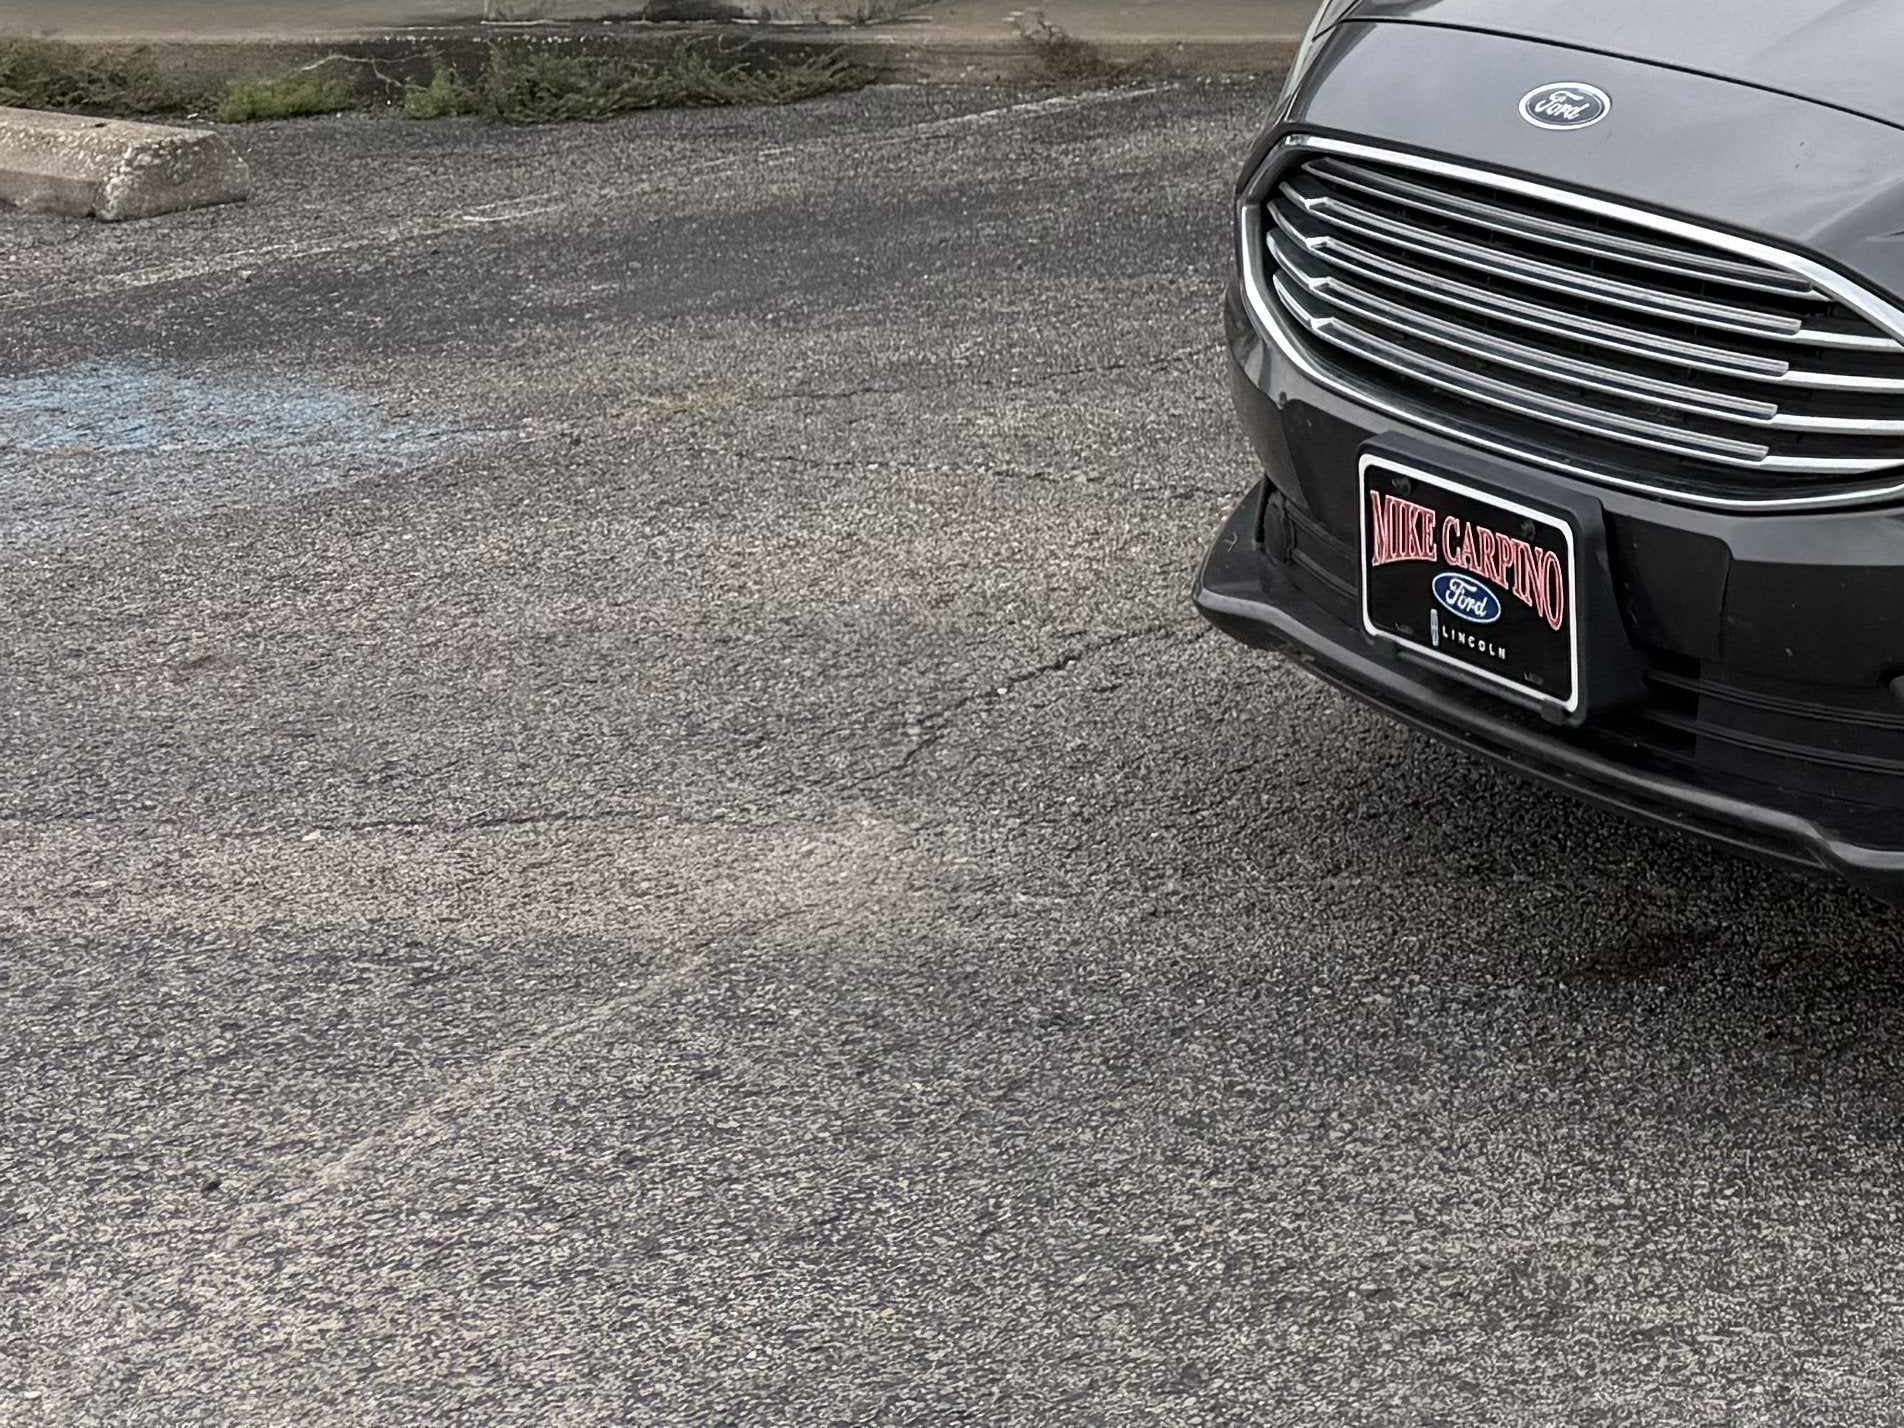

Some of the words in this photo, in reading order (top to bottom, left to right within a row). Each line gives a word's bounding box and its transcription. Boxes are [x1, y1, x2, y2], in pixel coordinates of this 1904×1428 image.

[1534, 90, 1591, 120] Ford
[1369, 489, 1438, 567] MIKE
[1441, 515, 1564, 631] CARPINO
[1445, 577, 1488, 618] Ford
[1442, 624, 1507, 660] LINCOLN
